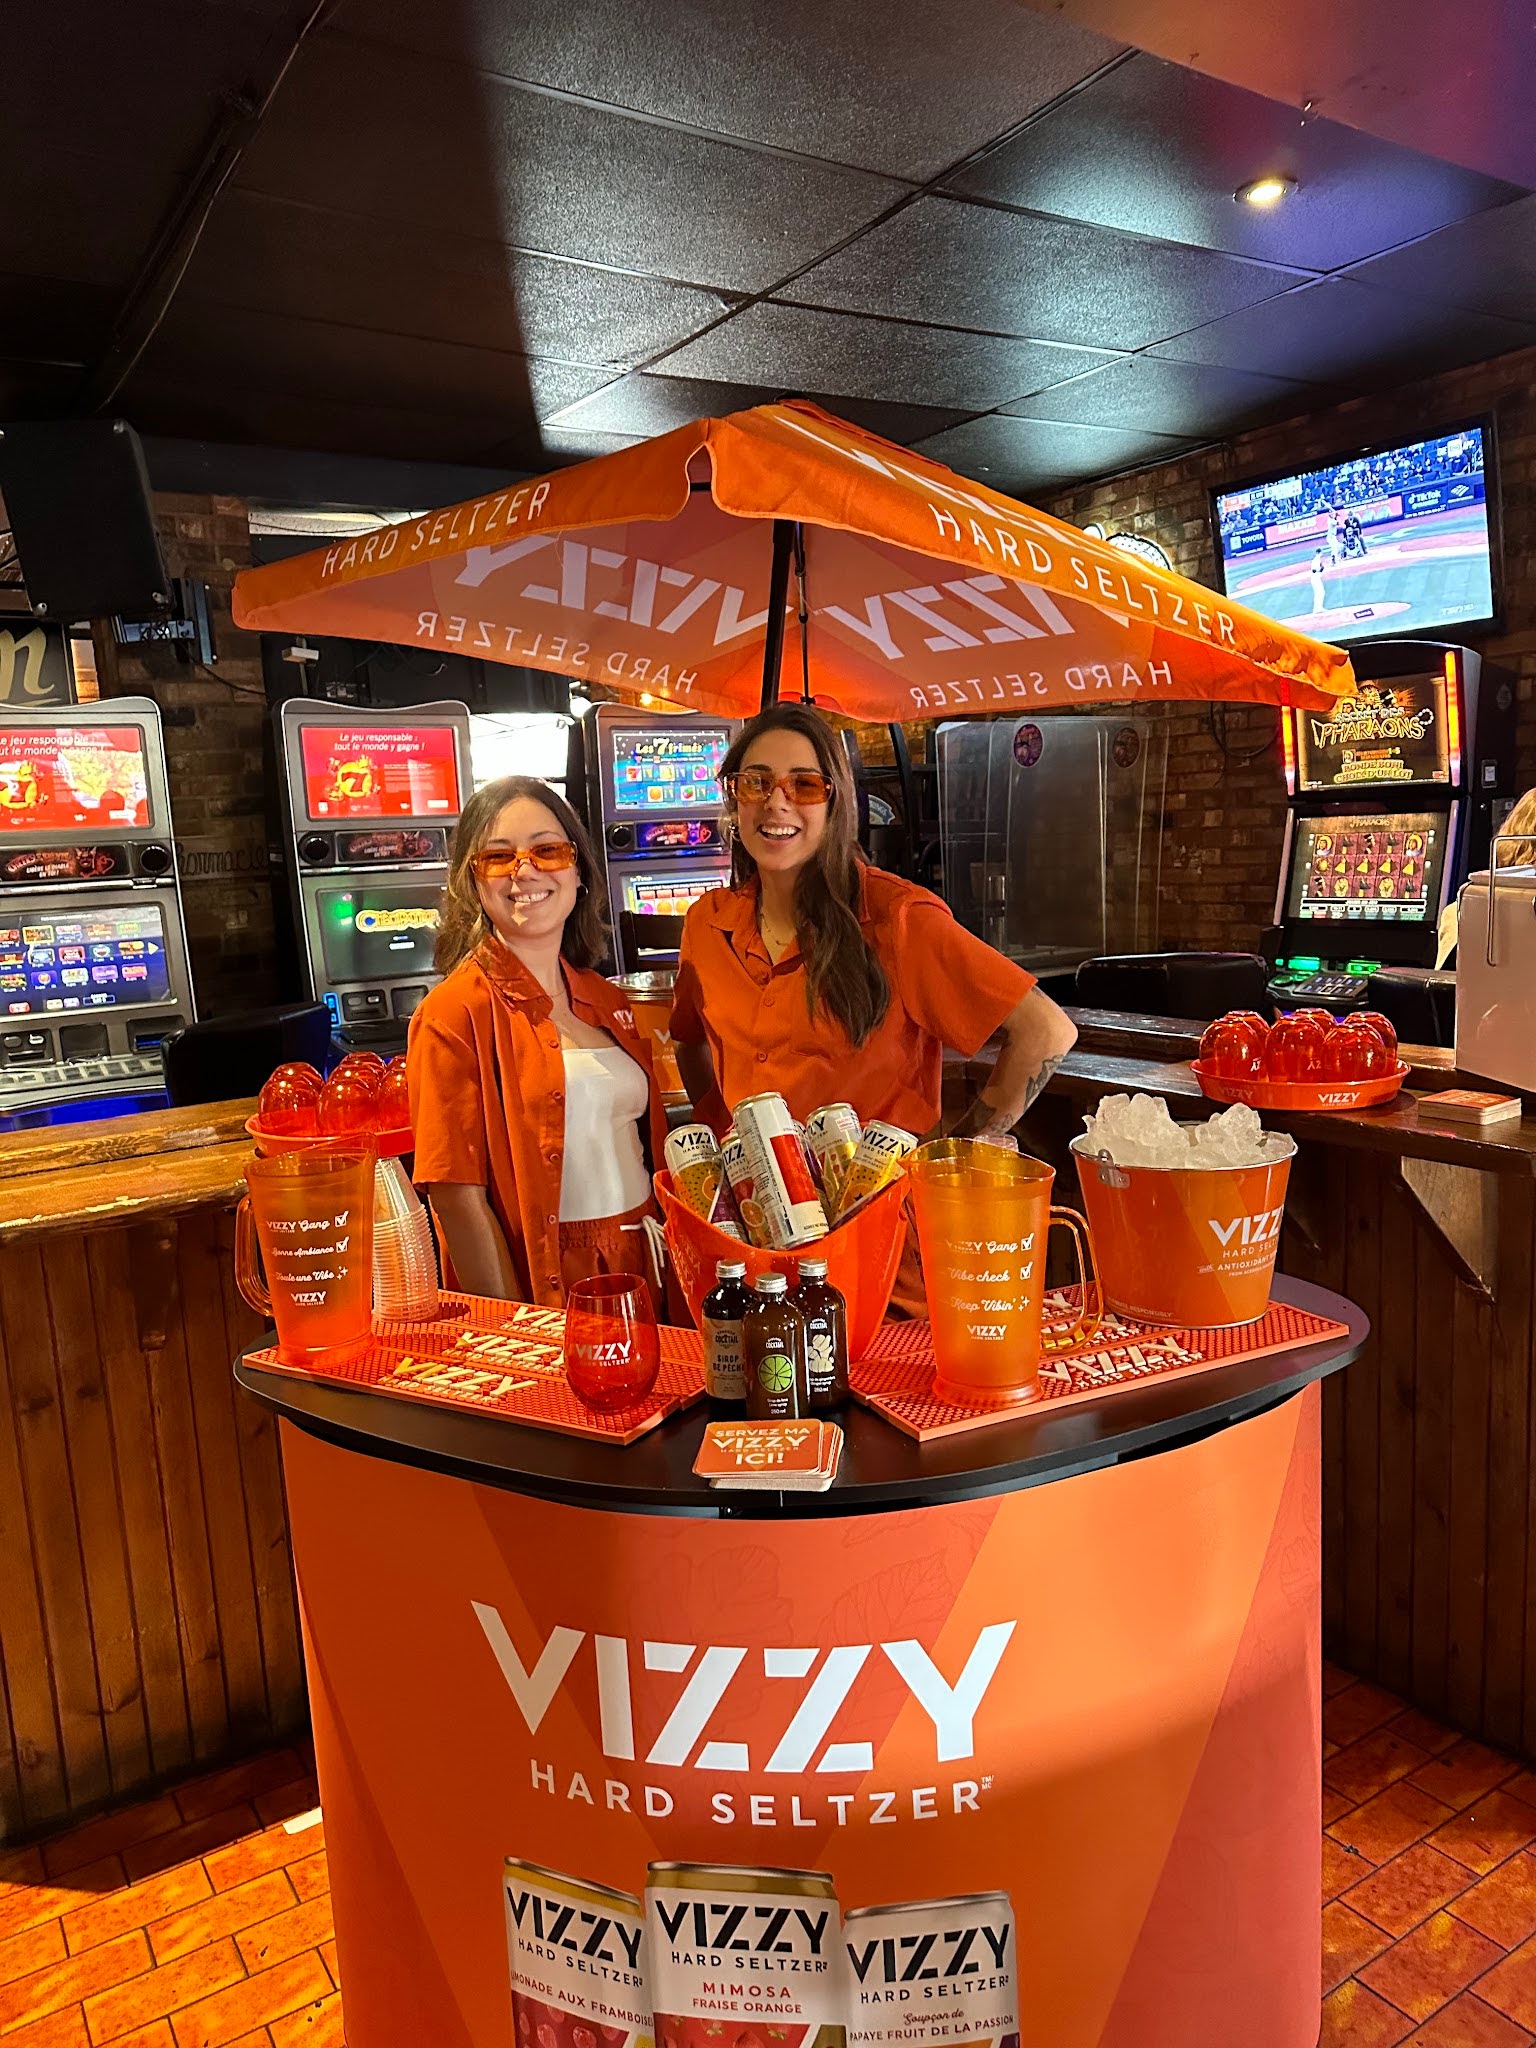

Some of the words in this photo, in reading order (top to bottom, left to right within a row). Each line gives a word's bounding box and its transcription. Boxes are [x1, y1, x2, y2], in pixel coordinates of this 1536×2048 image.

[321, 529, 398, 578] HARD
[410, 480, 551, 551] SELTZER
[1241, 533, 1265, 544] TOYOTA
[927, 503, 1053, 574] HARD
[1070, 556, 1236, 645] SELTZER
[340, 733, 349, 742] Le
[351, 733, 364, 744] jeu
[366, 733, 413, 744] responsable
[1311, 717, 1426, 749] PHARAONS
[10, 736, 26, 747] jeu
[397, 744, 420, 752] gagne
[24, 745, 58, 755] monde
[1318, 1092, 1361, 1104] VIZZY
[674, 1132, 714, 1148] VIZZ
[682, 1145, 700, 1154] HARD
[266, 1220, 297, 1230] VIZZY
[298, 1220, 331, 1232] Gang
[1208, 1204, 1284, 1246] VIZZ
[294, 1246, 334, 1258] Ambiance
[986, 1240, 1018, 1254] Gang
[1222, 1246, 1255, 1258] HARD
[1217, 1255, 1270, 1271] ANTIOXIDANT
[312, 1270, 334, 1280] Vibe
[948, 1267, 975, 1280] Vibe
[976, 1270, 1010, 1282] check
[290, 1290, 326, 1302] VIZZY
[952, 1296, 980, 1313] Keep
[981, 1298, 1016, 1312] Vibin'
[966, 1324, 1007, 1336] VIZZY
[715, 1335, 738, 1344] COCKTAIL
[575, 1340, 632, 1360] VIZZY
[713, 1362, 722, 1371] DE
[717, 1354, 740, 1363] SIROP
[393, 1357, 538, 1397] VIZZY
[715, 1428, 780, 1438] SERVEZ
[712, 1435, 808, 1449] VIZZY
[736, 1452, 784, 1464] ICI!
[470, 1600, 1017, 1773] VIZZY
[530, 1758, 675, 1818] HARD
[711, 1780, 981, 1827] SELTZER
[506, 1886, 642, 1969] VIZZY
[655, 1900, 829, 1954] VIZZY
[672, 1951, 722, 1967] HARD
[735, 1956, 823, 1972] SELTZER
[846, 1923, 1010, 1985] VIZZY
[518, 1938, 556, 1961] HARD
[566, 1956, 640, 1988] SELTZER
[702, 1982, 791, 1998] MIMOSA
[860, 1990, 911, 2004] HARD
[923, 1976, 1005, 1998] SELTZER
[558, 1990, 586, 2008] AUX
[692, 1998, 738, 2012] FRAISE
[743, 2002, 802, 2014] ORANGE
[902, 2011, 950, 2026] Soupçon
[951, 2008, 964, 2019] de
[850, 2030, 883, 2042] PAPAYE
[887, 2028, 926, 2040] FRUIT
[931, 2026, 950, 2036] DE
[954, 2021, 971, 2034] LA
[975, 2014, 1014, 2031] PASSION
